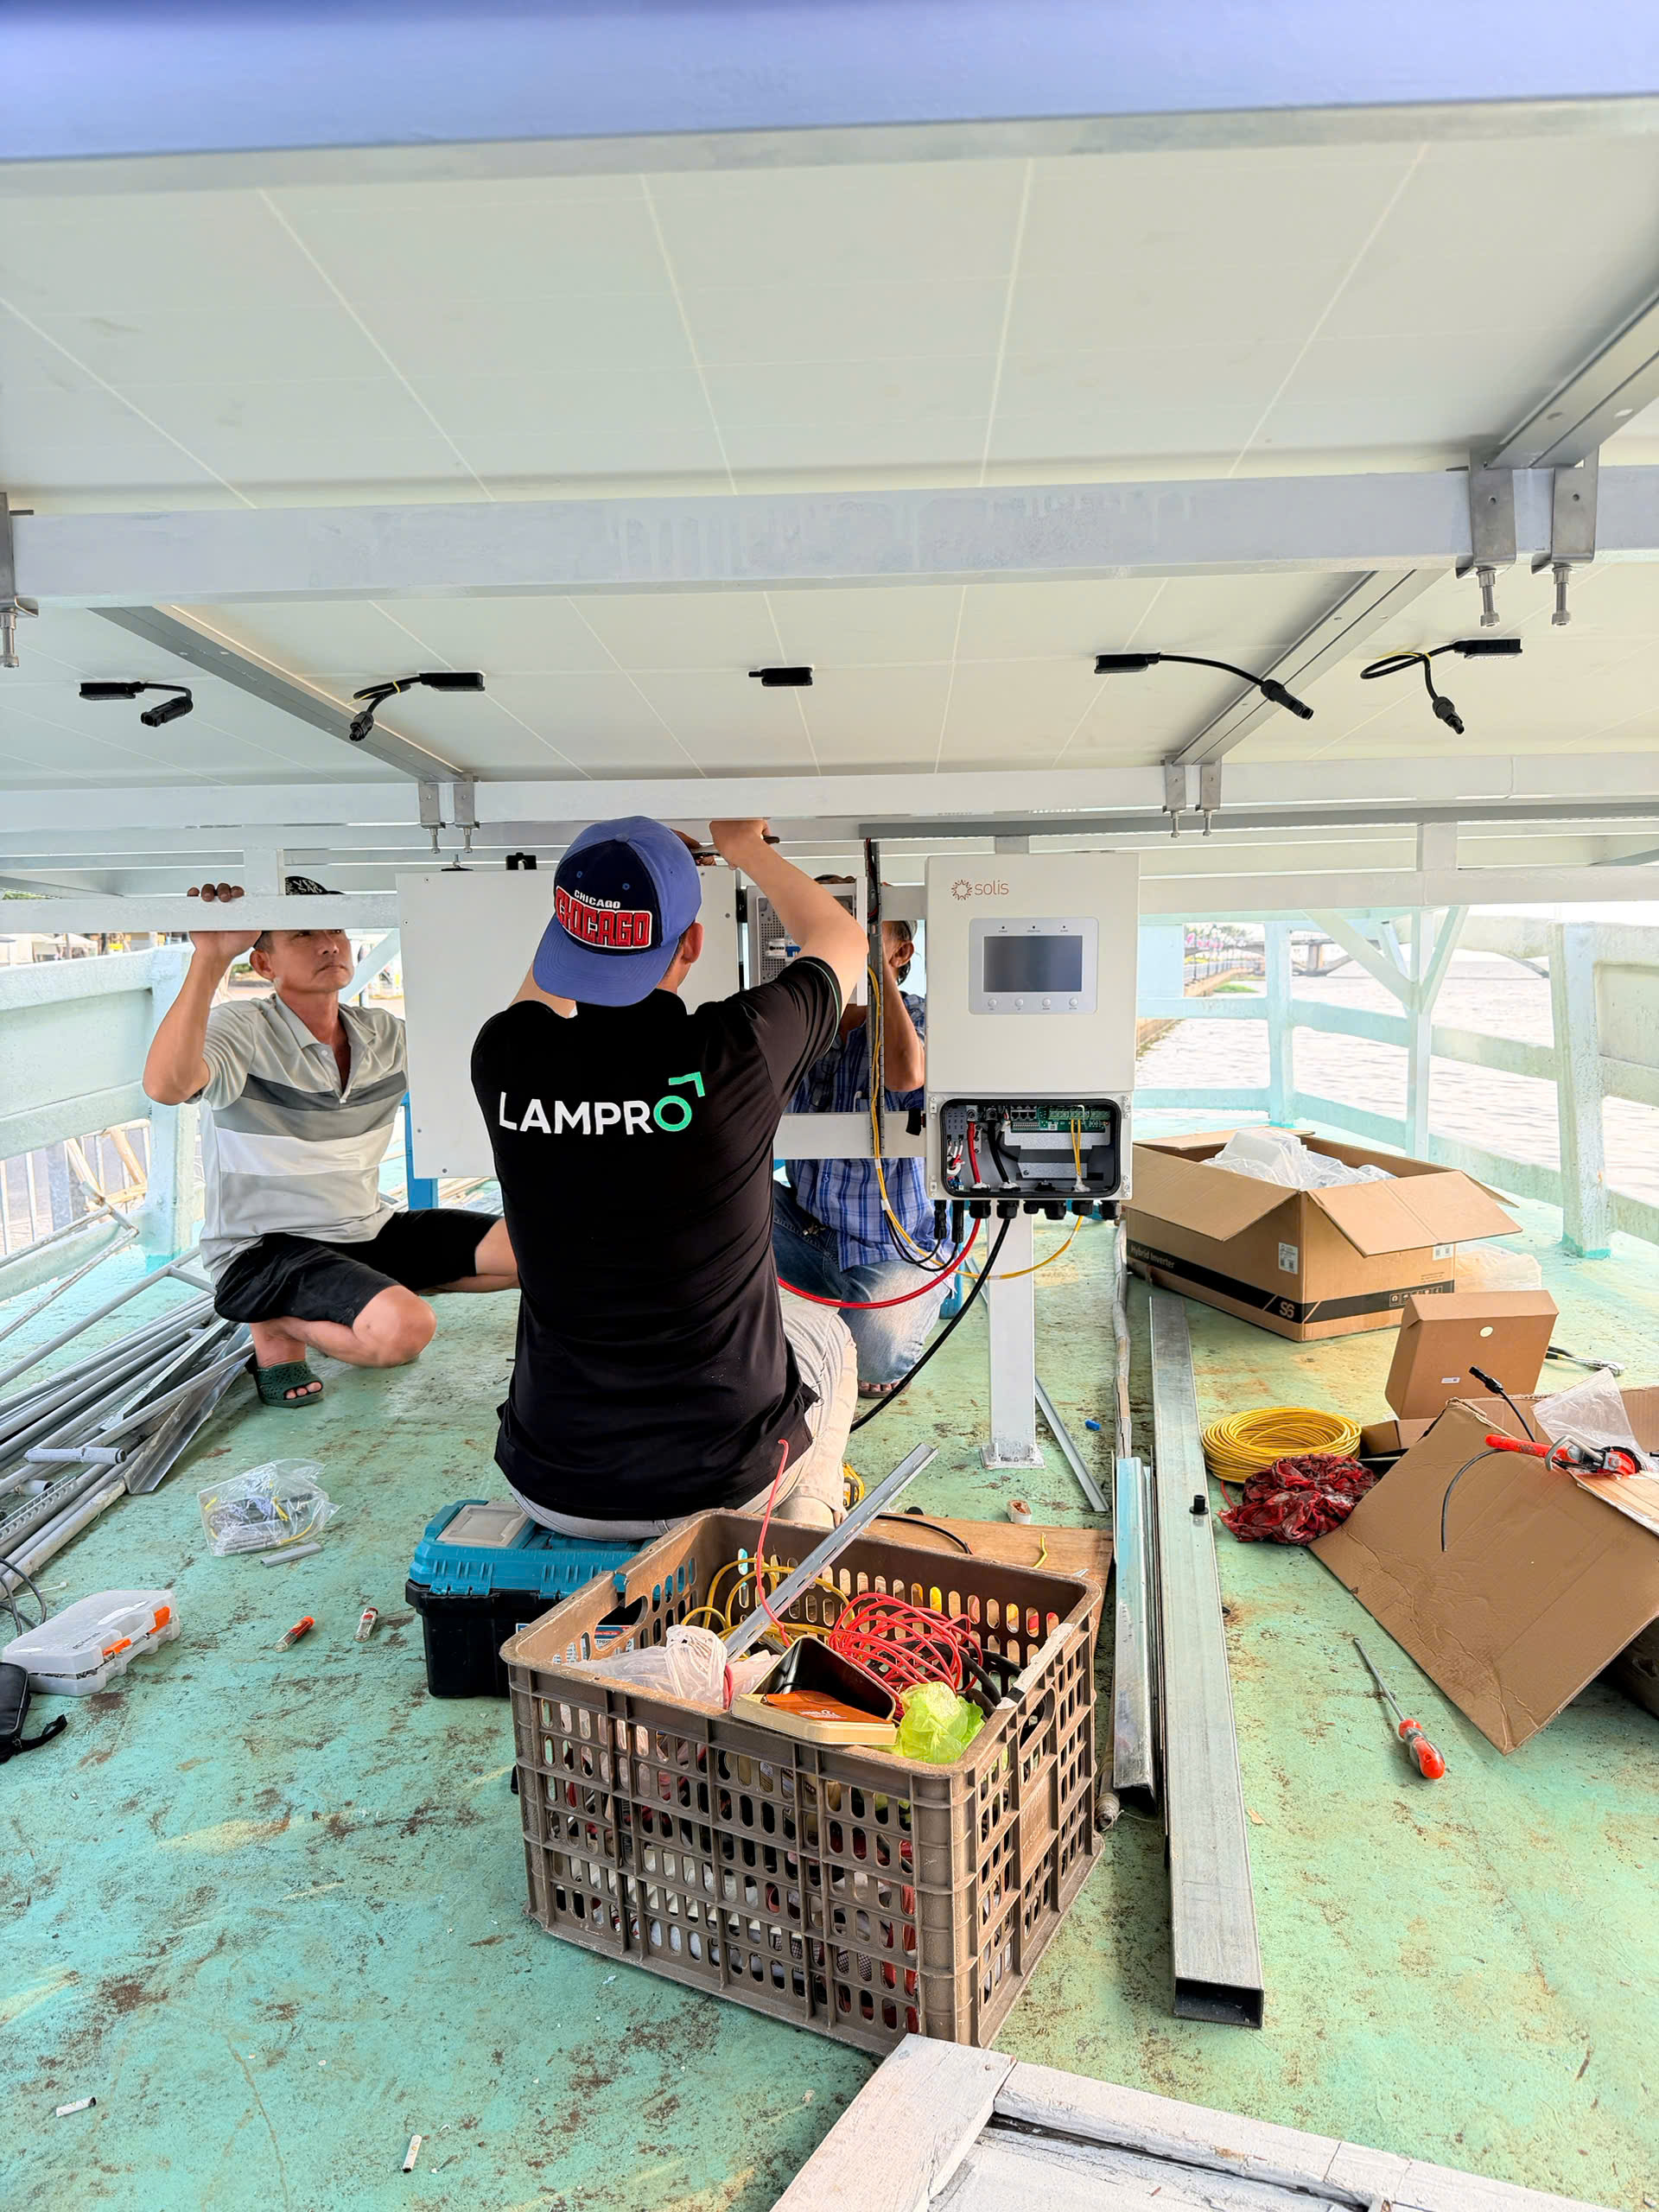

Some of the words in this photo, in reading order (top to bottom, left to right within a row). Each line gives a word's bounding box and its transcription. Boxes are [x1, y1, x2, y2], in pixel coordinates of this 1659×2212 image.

[974, 880, 1009, 895] solis
[574, 889, 621, 909] CHICAGO
[555, 886, 652, 949] CHICAGO
[499, 1090, 693, 1135] LAMPRO
[1130, 1244, 1150, 1259] Hybrid
[1150, 1251, 1175, 1268] Inverter
[1279, 1301, 1295, 1319] S6
